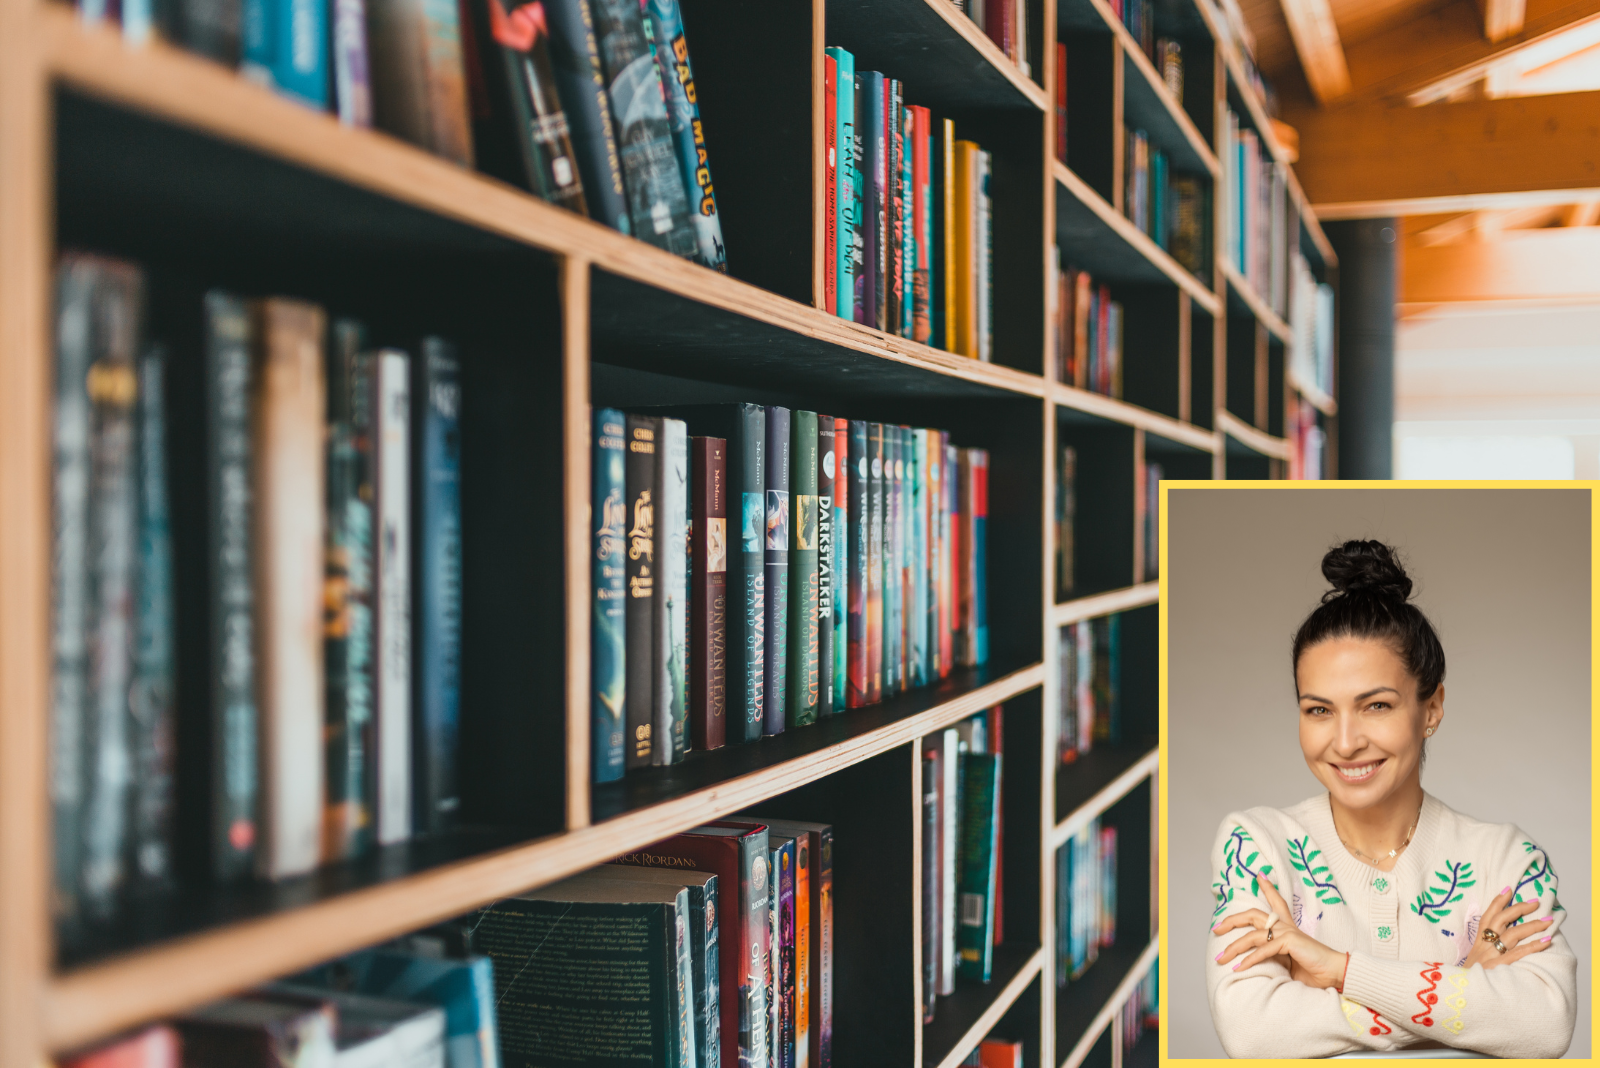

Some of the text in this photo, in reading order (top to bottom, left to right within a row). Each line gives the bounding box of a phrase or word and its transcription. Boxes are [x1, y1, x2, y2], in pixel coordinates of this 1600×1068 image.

[672, 33, 716, 217] BAD MAGIC
[892, 197, 904, 242] LOVE
[892, 248, 904, 301] STORY
[818, 496, 832, 618] DARKSTALKER
[747, 574, 755, 626] ISLAND
[713, 598, 726, 717] UNWANTEDS
[747, 635, 755, 651] OF
[754, 574, 764, 722] UNWANTEDS
[773, 634, 780, 646] OF
[802, 627, 808, 639] OF
[808, 572, 819, 707] UNWANTEDS
[614, 852, 641, 864] RICK
[747, 942, 763, 1068] OF ATHEN
